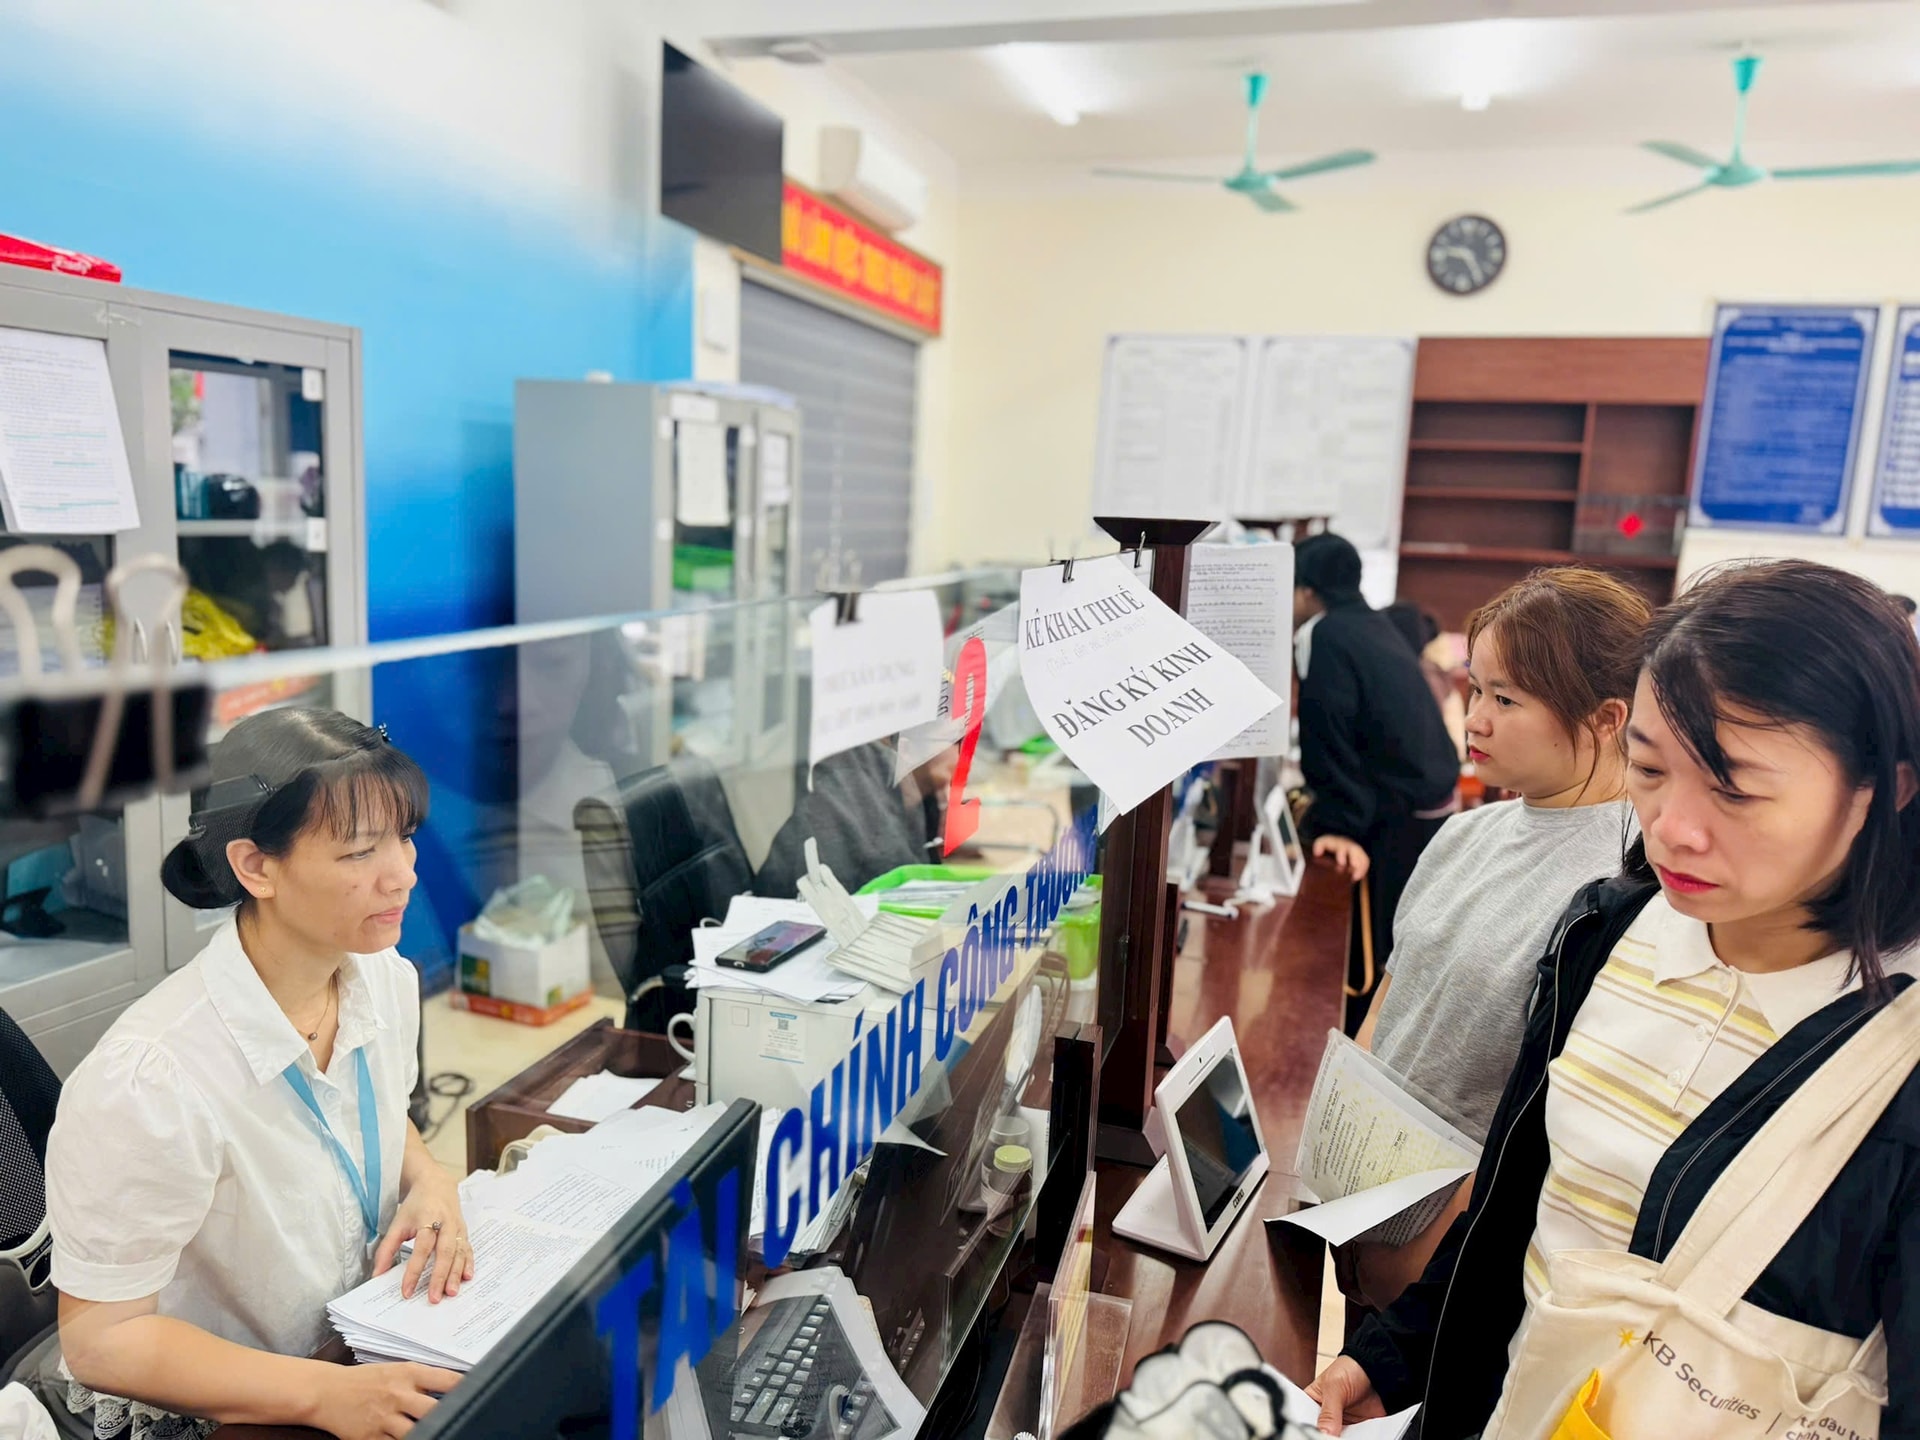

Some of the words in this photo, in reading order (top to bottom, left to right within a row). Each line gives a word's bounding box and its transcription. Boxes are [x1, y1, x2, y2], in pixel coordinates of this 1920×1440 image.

[1045, 607, 1092, 643] KHAI
[1052, 689, 1127, 739] ĐĂNG
[1117, 666, 1159, 702] KÝ
[1150, 642, 1213, 682] KINH
[1126, 687, 1215, 747] DOANH
[943, 637, 987, 857] 2
[763, 978, 925, 1270] CHÍNH
[935, 885, 1018, 1062] CÔNG
[1643, 1330, 1677, 1367] KB
[1675, 1363, 1761, 1420] Securities
